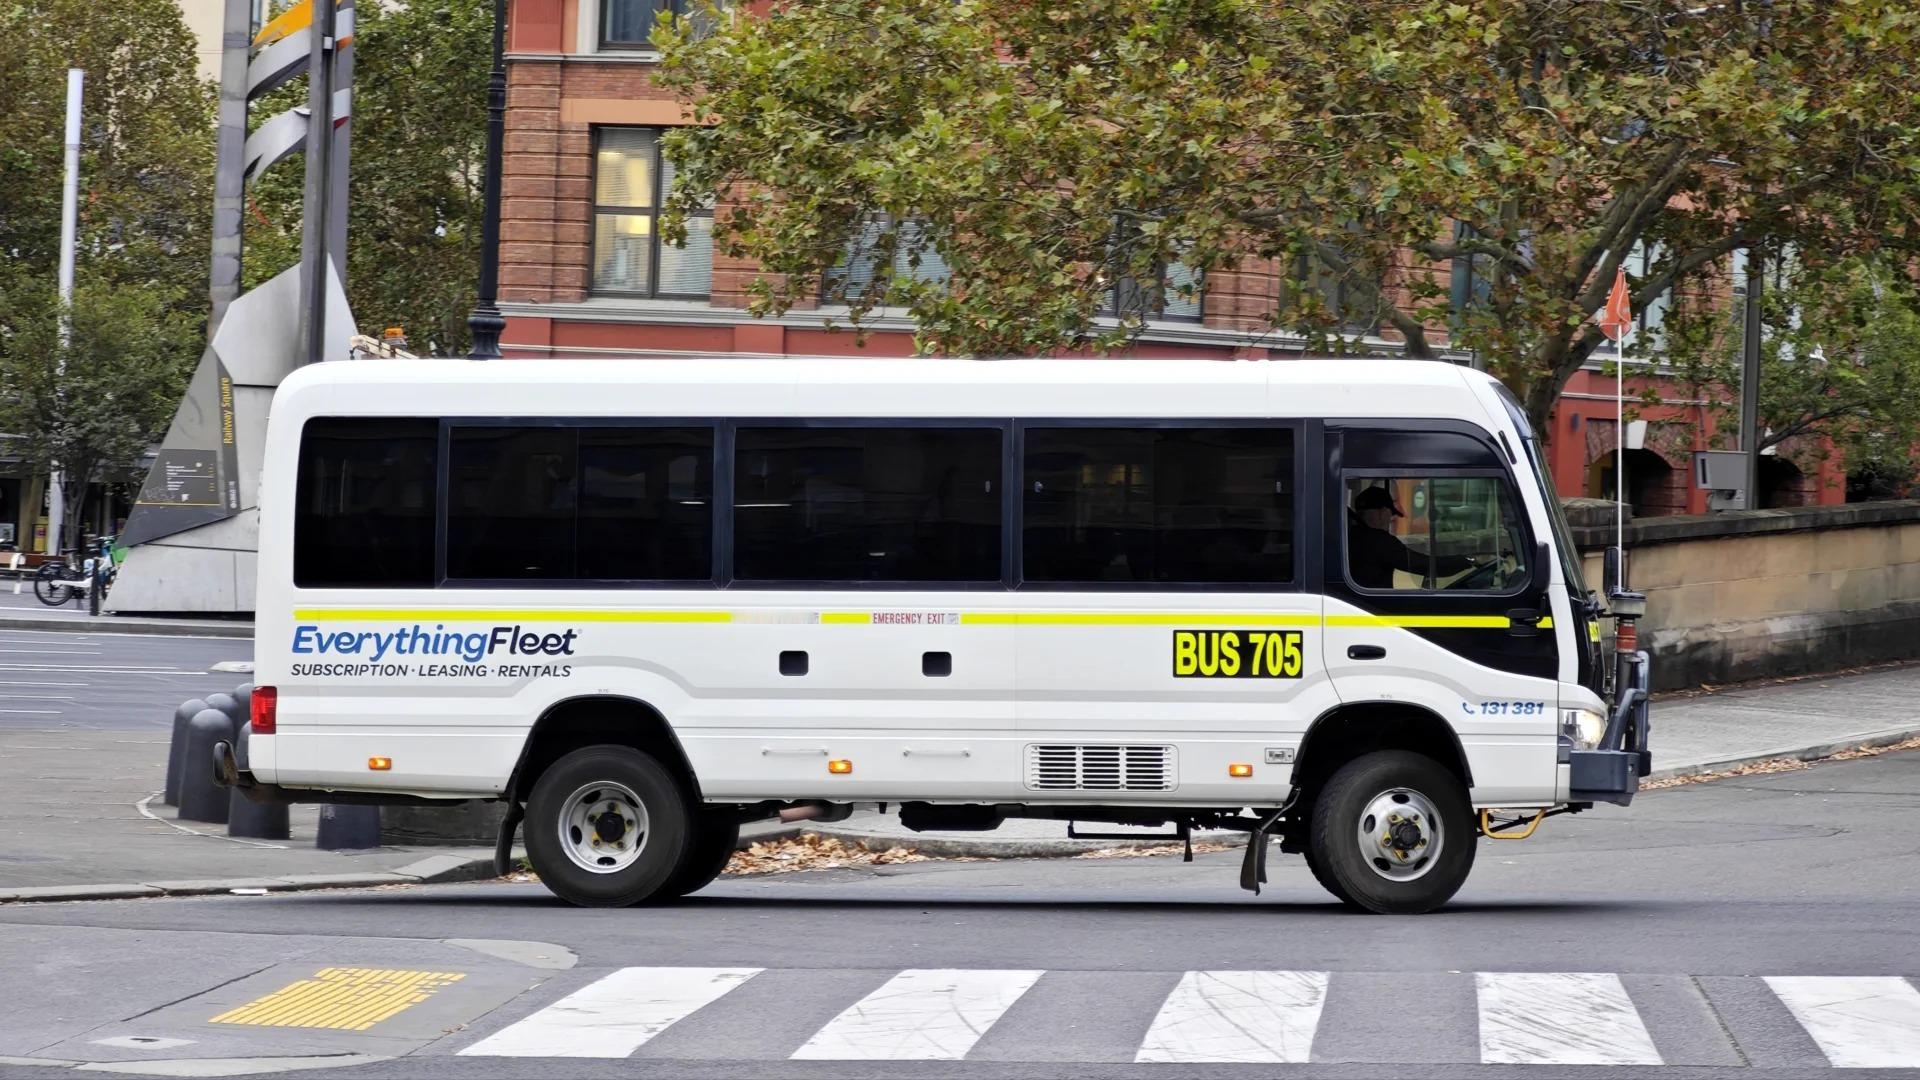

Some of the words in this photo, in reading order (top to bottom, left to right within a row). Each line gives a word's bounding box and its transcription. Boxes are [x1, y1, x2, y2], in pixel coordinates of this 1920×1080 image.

[221, 377, 232, 408] Square
[223, 410, 234, 444] Railway
[873, 613, 922, 624] EMERGENCY
[928, 613, 945, 624] EXIT
[292, 624, 577, 663] EverythingFleet
[1176, 632, 1240, 676] BUS
[1249, 633, 1301, 676] 705
[291, 663, 407, 676] SUBSCRIPTION
[418, 664, 487, 677] LEASING
[498, 665, 572, 678] RENTALS
[1480, 702, 1508, 714] 131
[1512, 702, 1544, 714] 381
